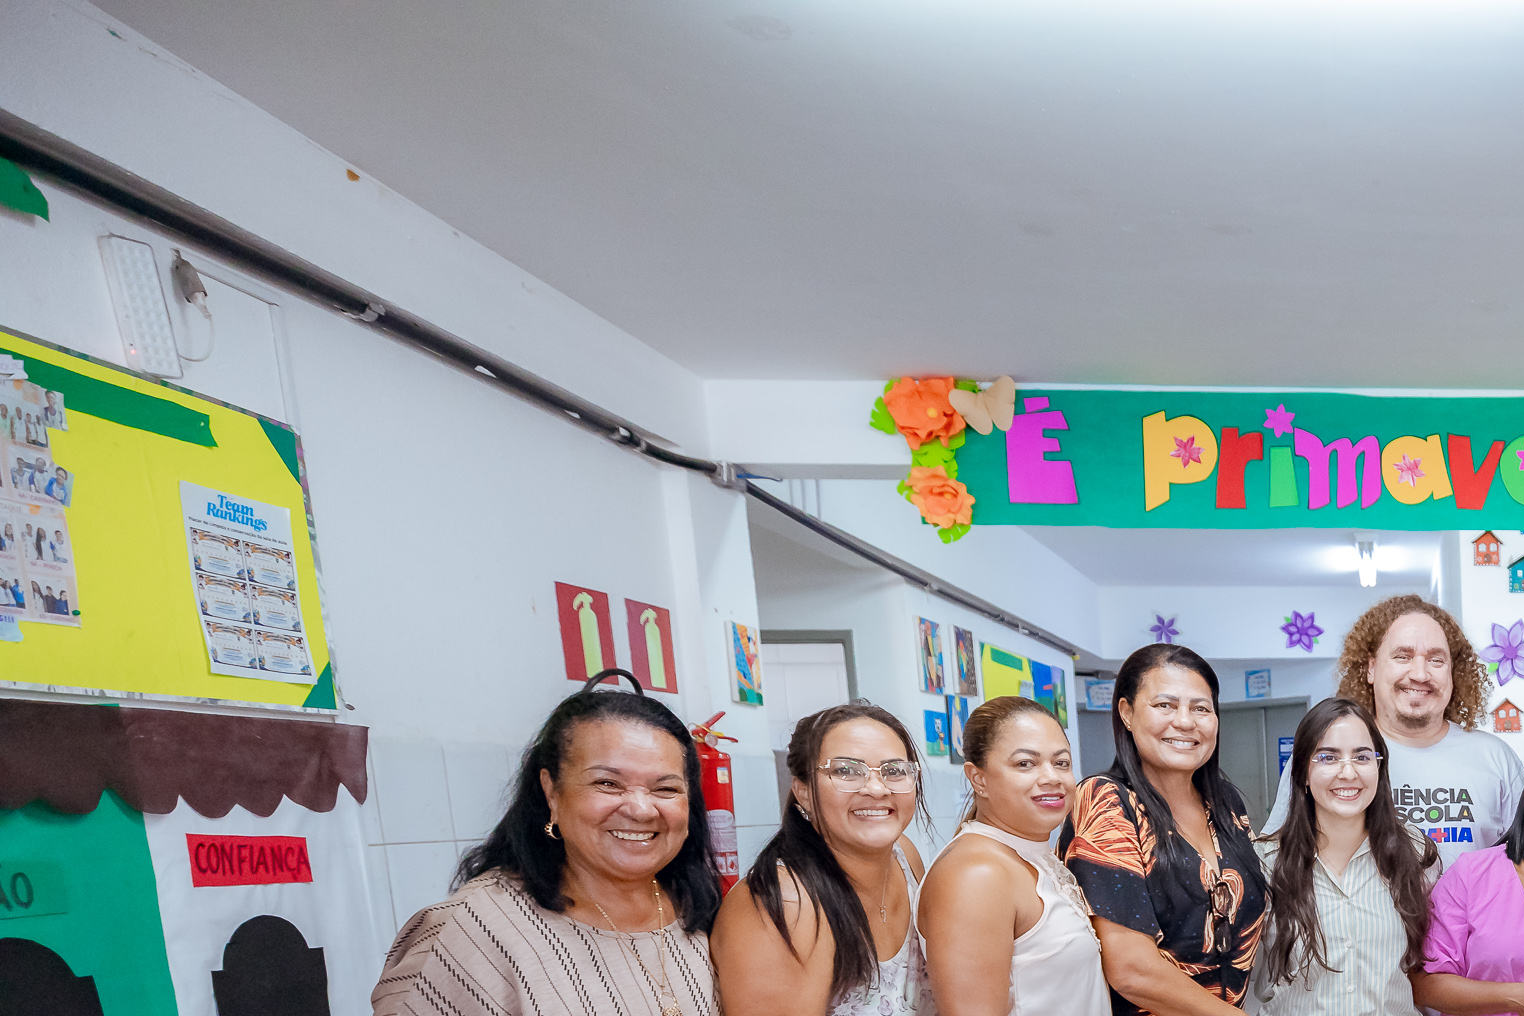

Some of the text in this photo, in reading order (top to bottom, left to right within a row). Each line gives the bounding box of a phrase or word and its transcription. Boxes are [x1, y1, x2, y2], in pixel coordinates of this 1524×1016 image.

[1005, 396, 1079, 504] É
[206, 501, 268, 532] Rankings
[217, 494, 254, 517] Team
[1393, 784, 1474, 806] IÊNCIA
[1396, 805, 1475, 824] SCOLA
[195, 842, 311, 882] CONFIANÇA
